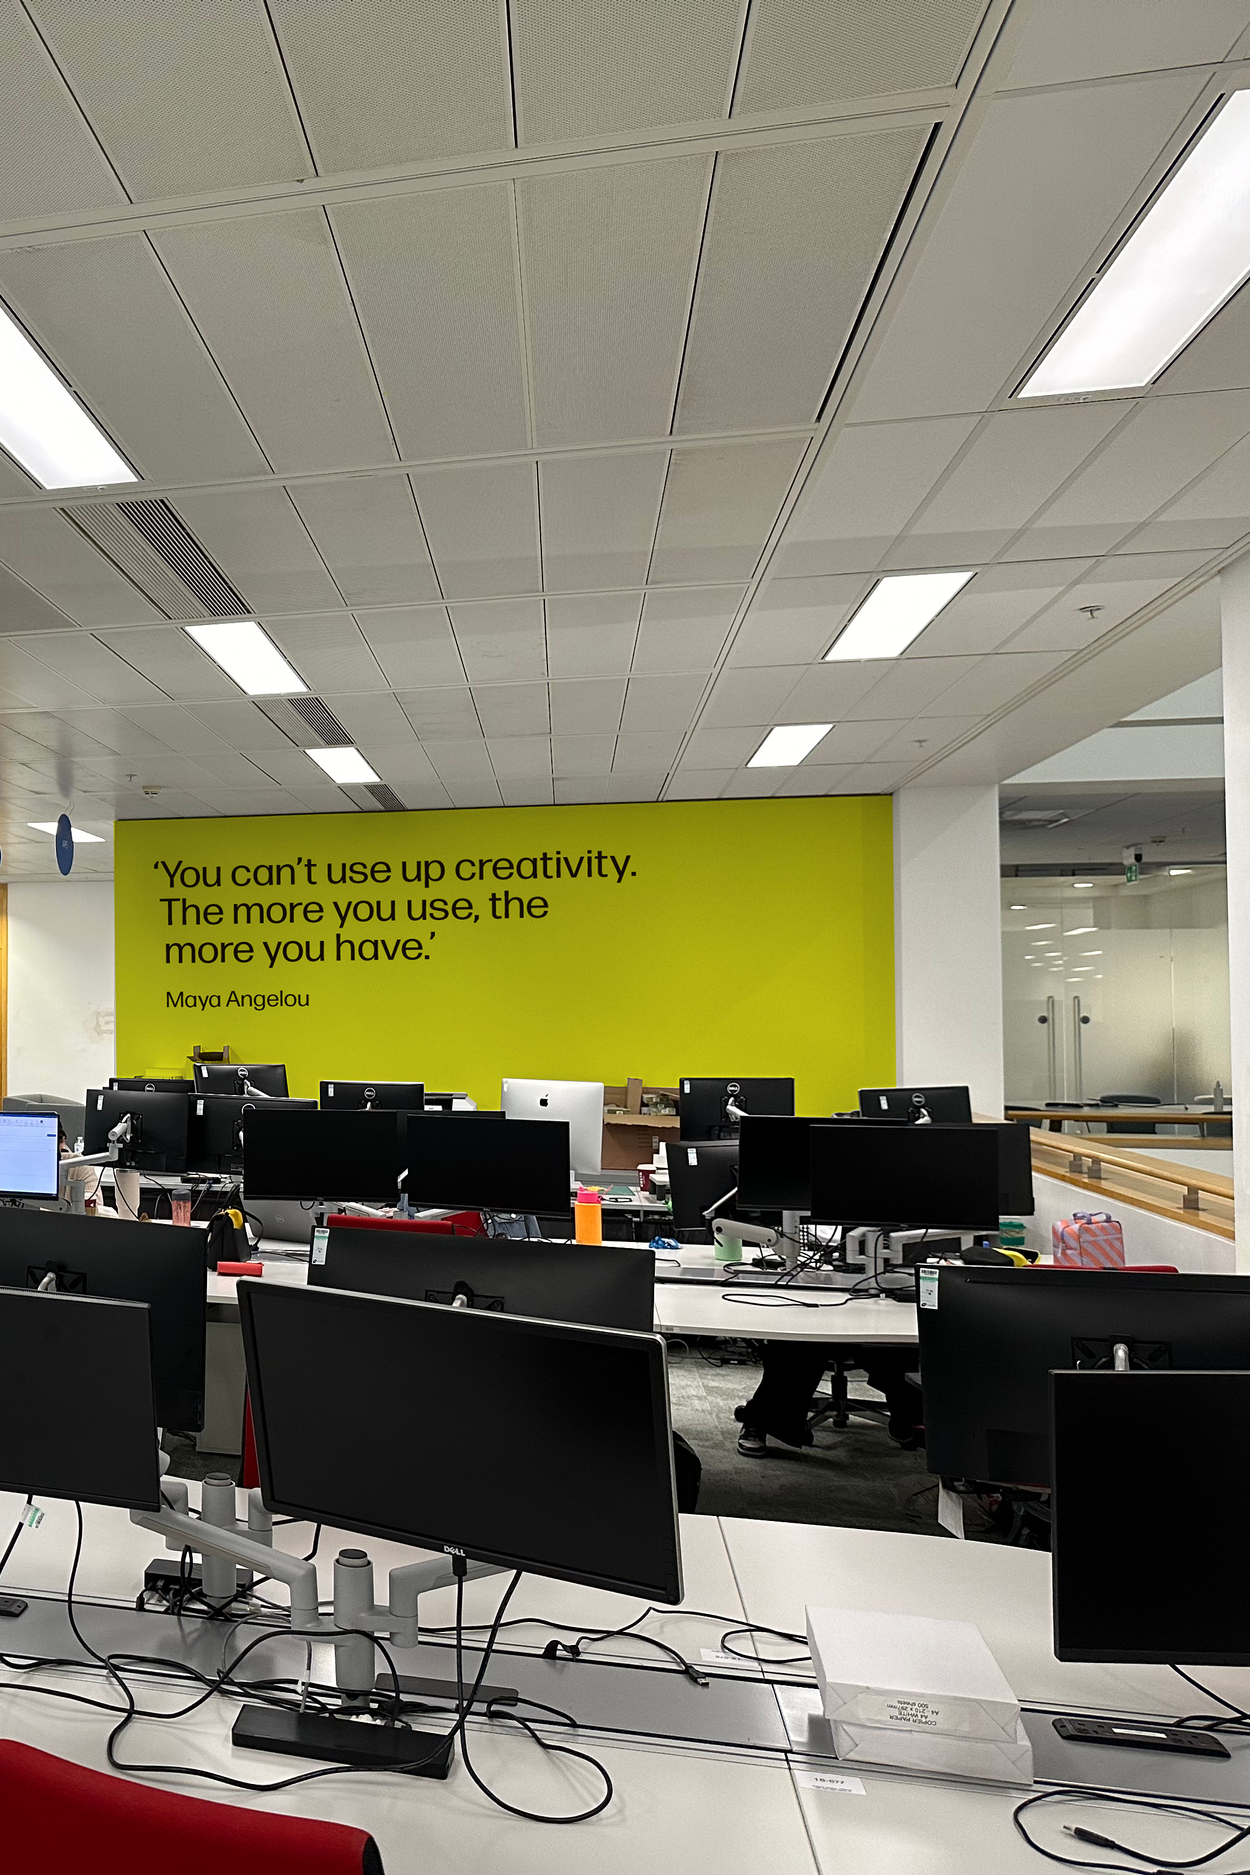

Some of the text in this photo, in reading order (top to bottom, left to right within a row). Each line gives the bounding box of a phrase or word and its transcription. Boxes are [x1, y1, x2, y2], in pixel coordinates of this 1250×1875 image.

[154, 849, 637, 888] ‘You can’t use up creativity.
[159, 890, 548, 929] The more you use, the
[165, 931, 436, 968] more you have.’
[166, 990, 310, 1011] Maya Angelou
[443, 1545, 466, 1557] DELL
[897, 1699, 916, 1707] sheets
[889, 1714, 937, 1726] COPIER PAPER
[898, 1710, 918, 1718] WHITE
